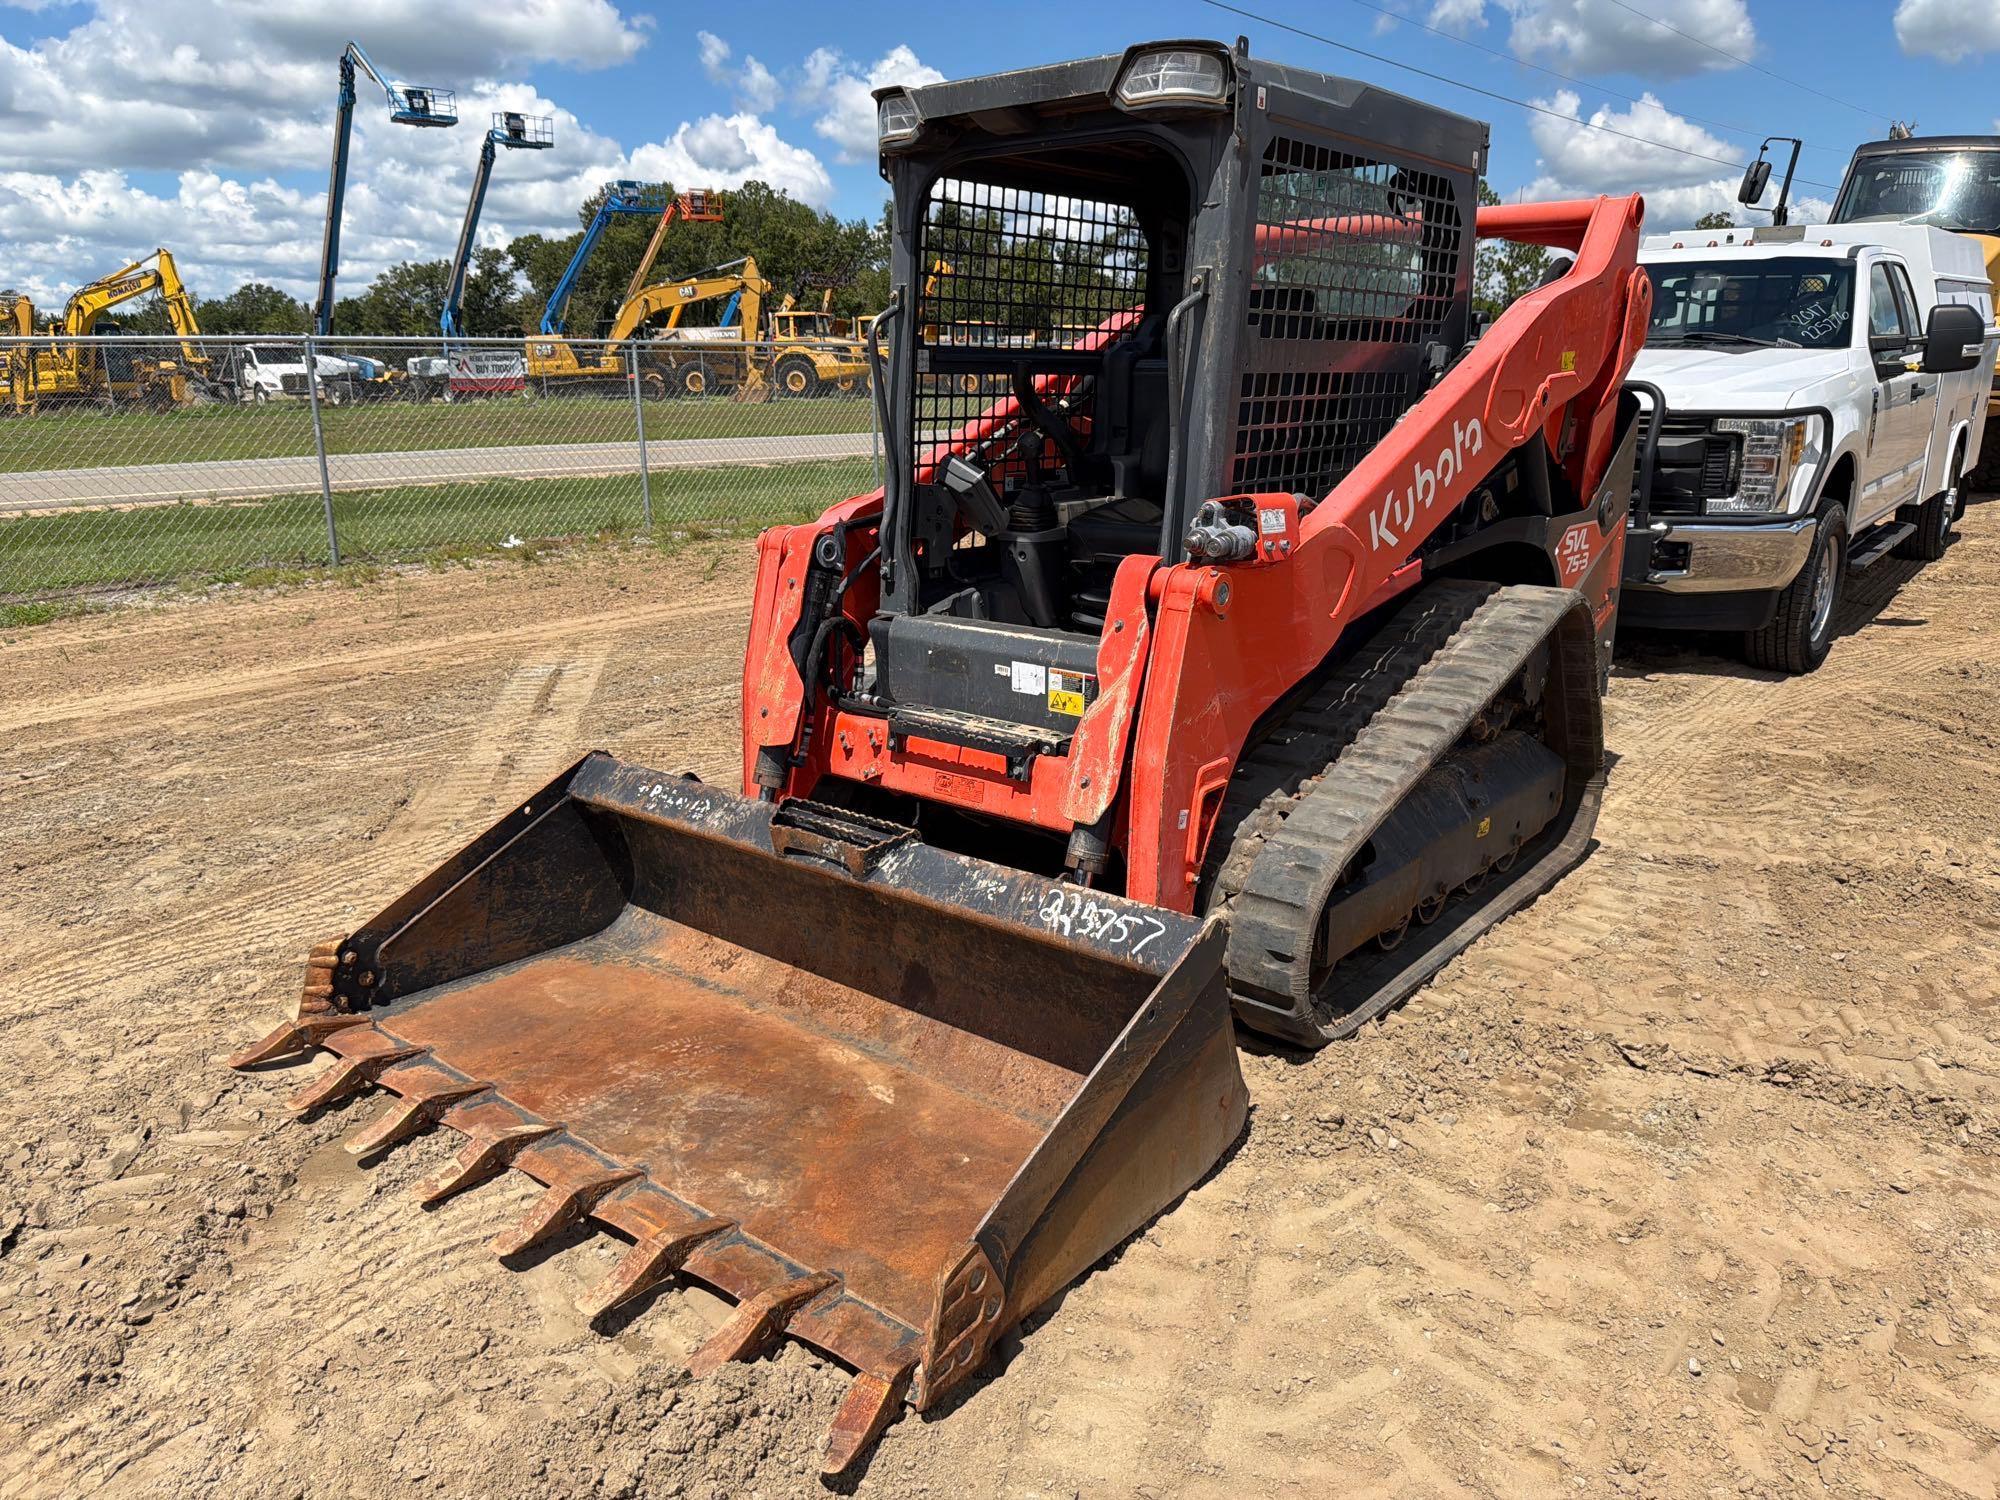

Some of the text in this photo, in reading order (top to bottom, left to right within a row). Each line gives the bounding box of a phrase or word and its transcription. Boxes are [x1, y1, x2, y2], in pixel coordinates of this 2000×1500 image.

[107, 280, 142, 299] KOMATSU
[679, 286, 694, 298] CAT
[1791, 301, 1827, 326] 2017
[1801, 311, 1850, 340] 225776
[535, 344, 553, 357] CAT
[475, 364, 489, 373] BUY
[1369, 418, 1482, 551] Kubota
[1563, 528, 1589, 555] SVL
[1566, 552, 1589, 574] 75-3
